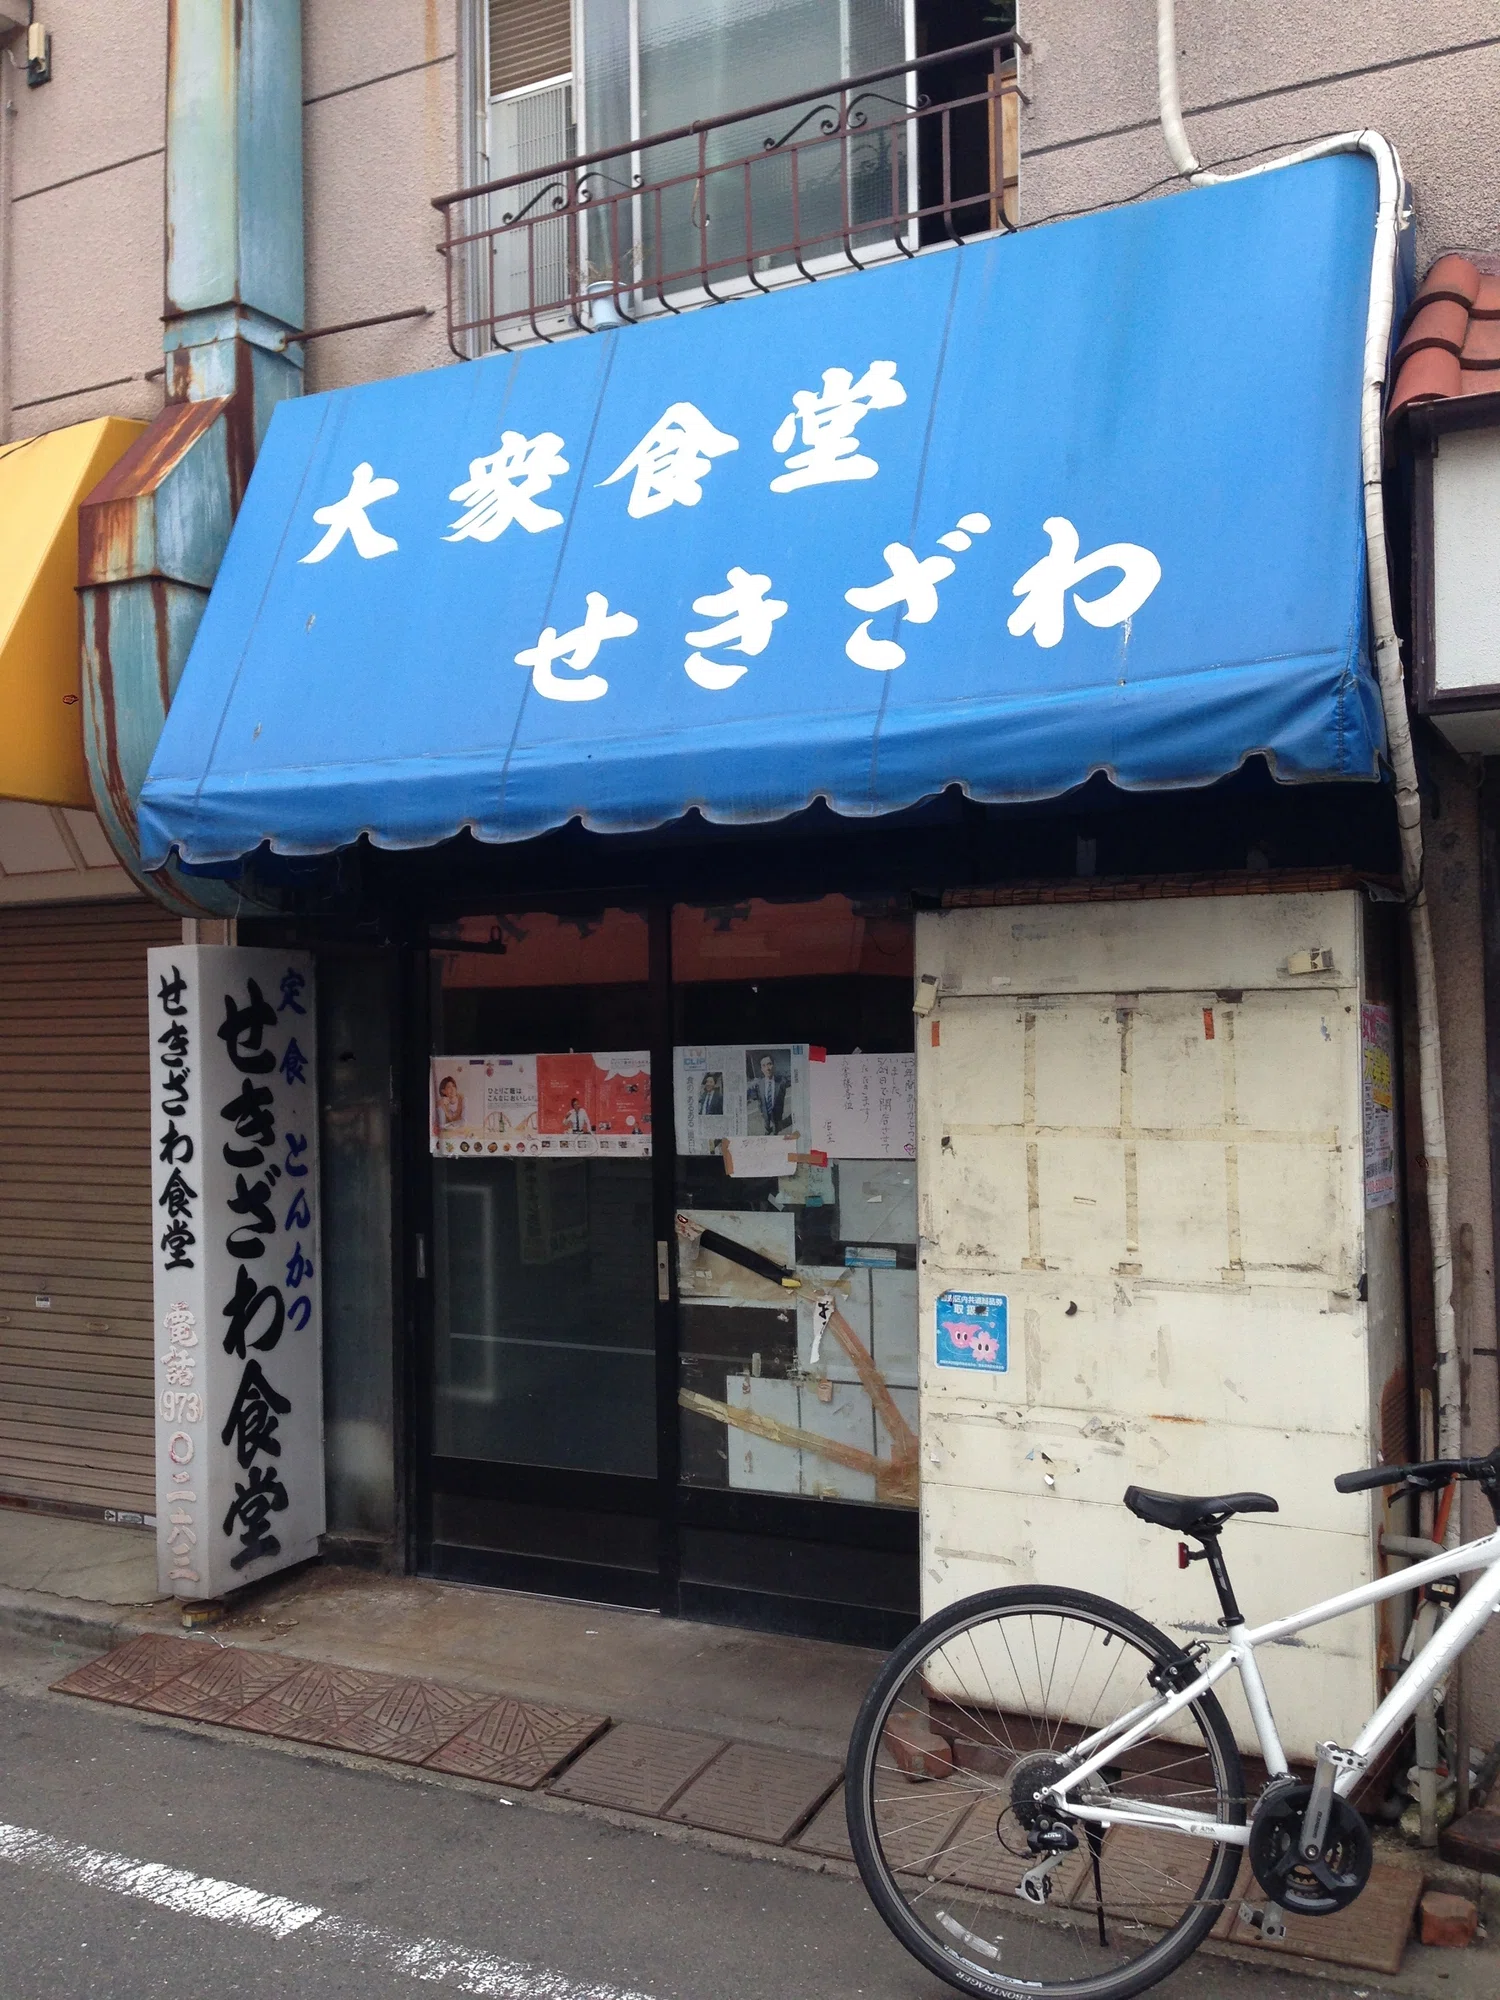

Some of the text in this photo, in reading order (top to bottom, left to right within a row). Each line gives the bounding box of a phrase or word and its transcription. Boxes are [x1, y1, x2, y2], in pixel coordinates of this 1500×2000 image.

[297, 360, 907, 564] 大衆食堂
[514, 512, 1162, 702] せきざわ
[157, 965, 198, 1271] せきざわ食堂
[217, 977, 291, 1571] せきざわ食堂
